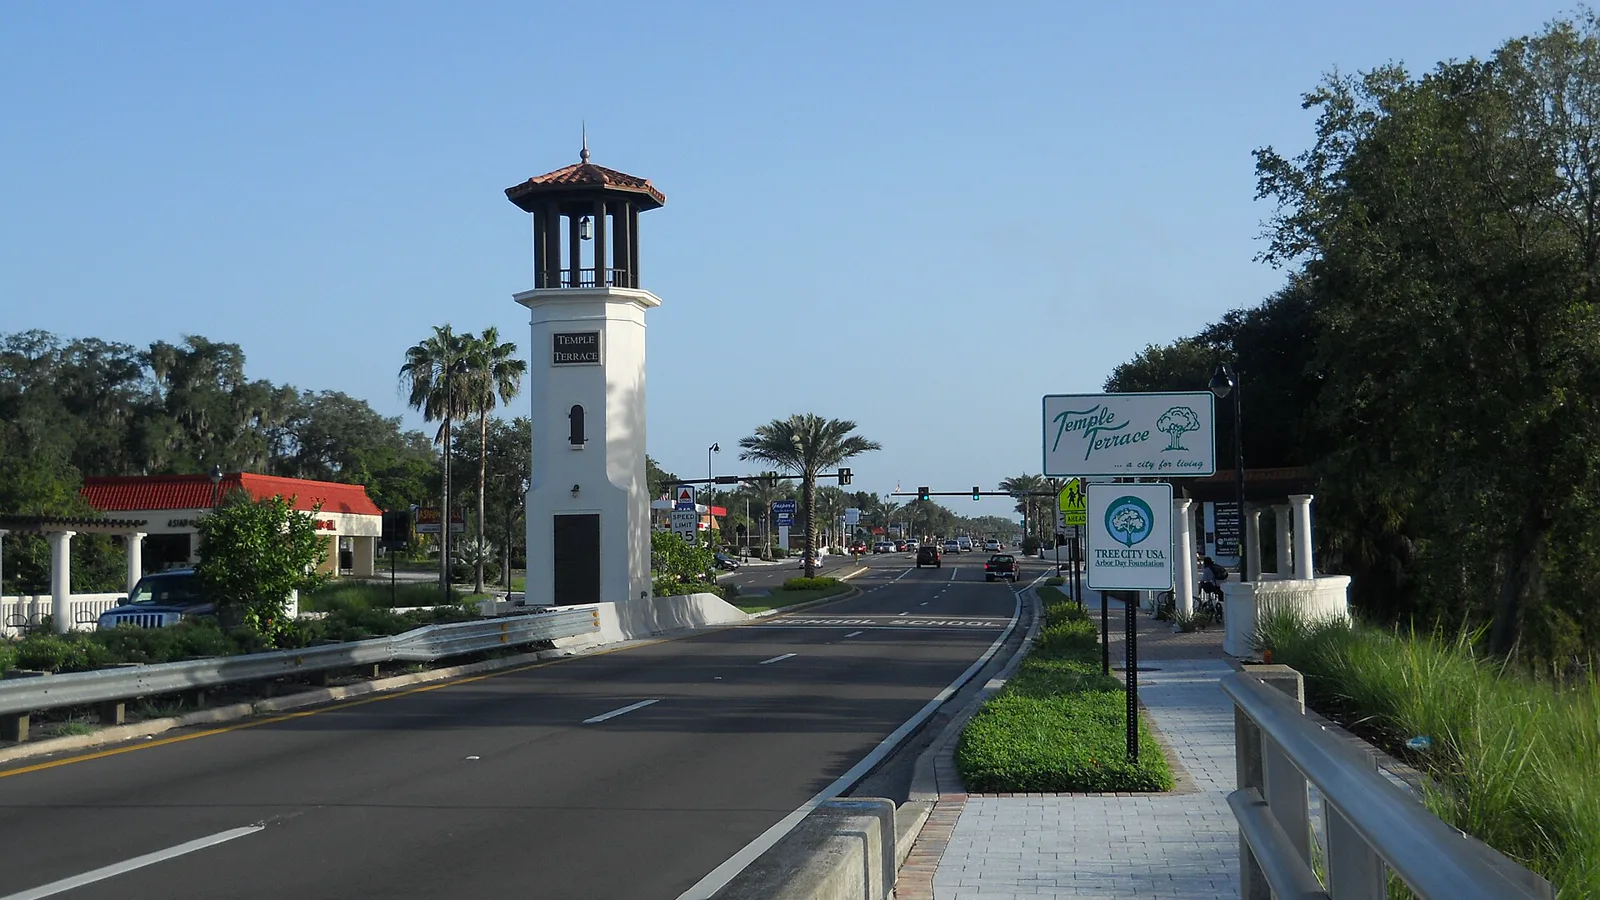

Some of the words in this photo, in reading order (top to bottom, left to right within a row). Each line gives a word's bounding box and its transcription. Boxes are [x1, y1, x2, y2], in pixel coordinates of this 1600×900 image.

[557, 335, 595, 345] TEMPLE
[554, 352, 598, 361] TERRACE
[1052, 403, 1115, 452] Temple
[1083, 420, 1150, 461] Terrace
[1137, 460, 1155, 470] city
[1157, 459, 1172, 470] for
[1176, 459, 1204, 470] living
[672, 513, 695, 521] SPEED
[674, 521, 692, 529] LIMIT
[1094, 549, 1120, 559] TREE
[1120, 549, 1144, 559] CITY
[1145, 549, 1165, 559] USA
[1094, 559, 1114, 567] Arbor
[1114, 559, 1127, 568] Day
[1128, 559, 1164, 567] Foundation
